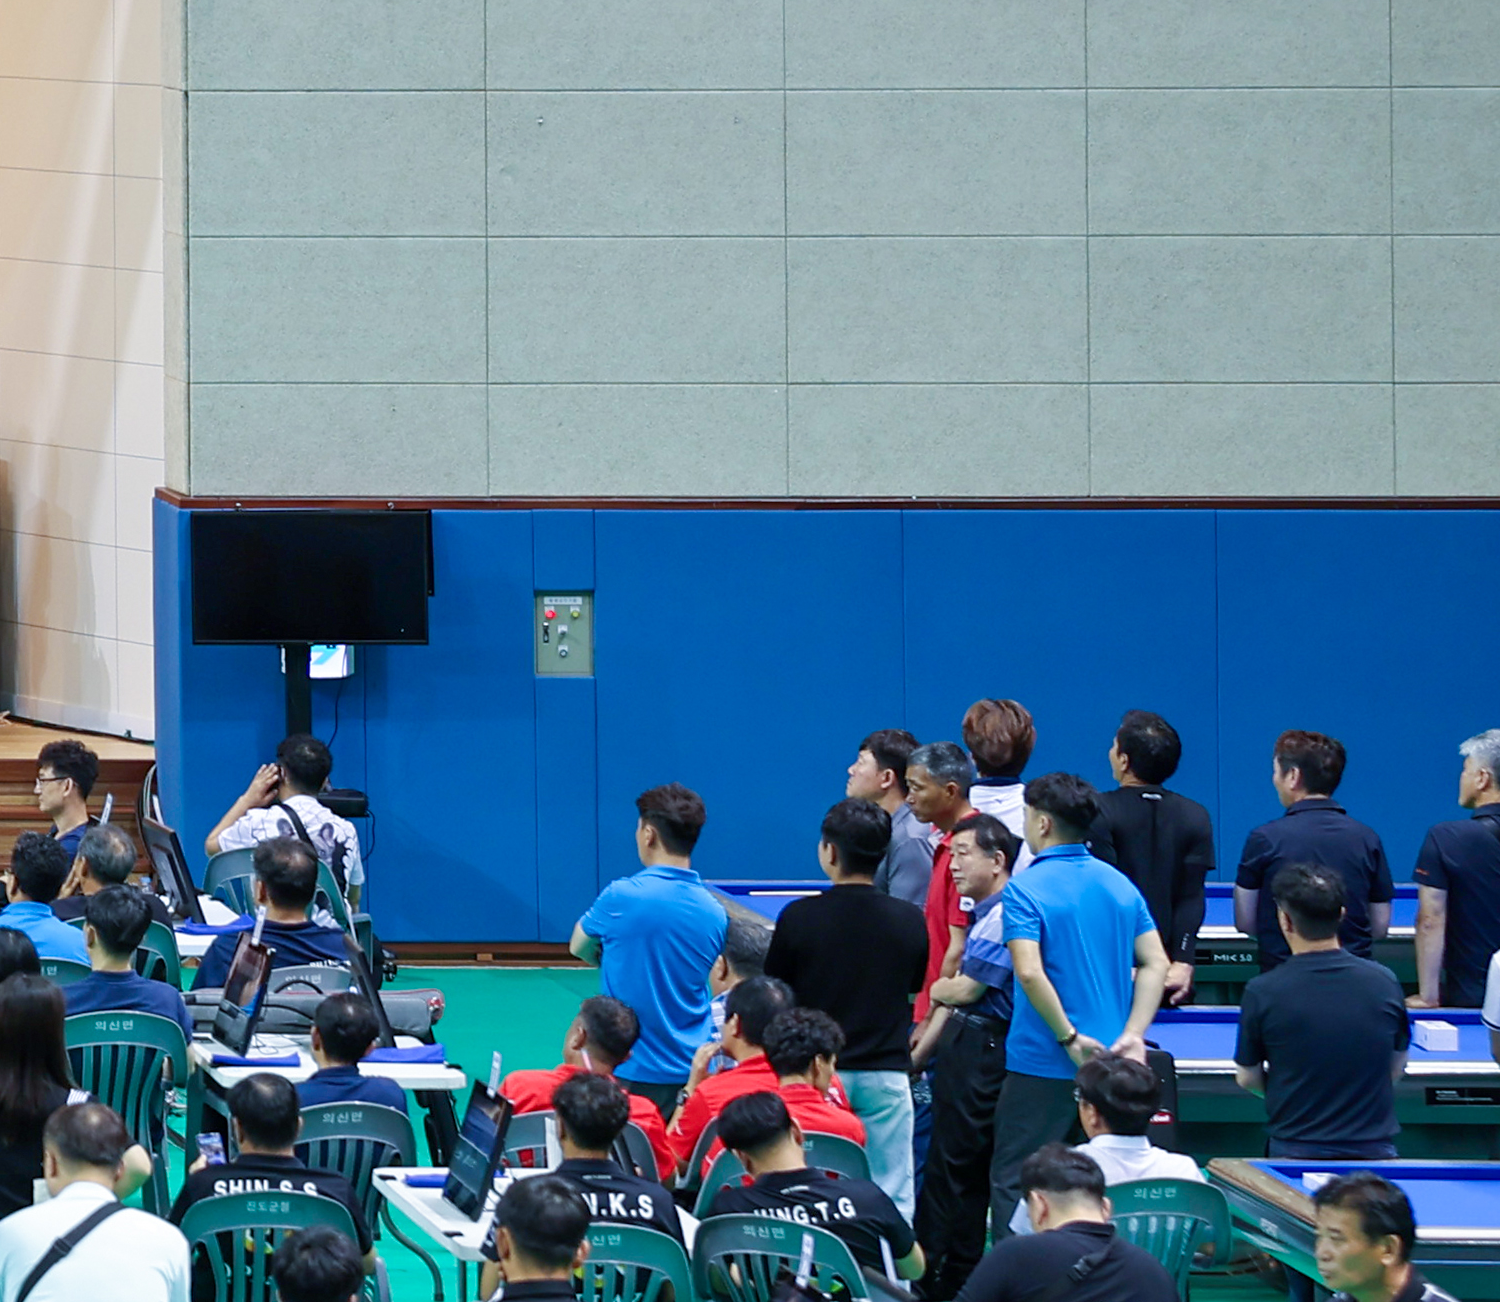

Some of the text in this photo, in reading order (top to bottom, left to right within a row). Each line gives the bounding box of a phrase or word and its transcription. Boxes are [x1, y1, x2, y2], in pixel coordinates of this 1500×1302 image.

[94, 1019, 134, 1031] 의신면
[322, 1110, 363, 1124] 의신면
[1133, 1187, 1177, 1200] 의신면
[581, 1192, 654, 1220] N.K.S
[742, 1225, 786, 1239] 의신면
[591, 1234, 621, 1247] 신면
